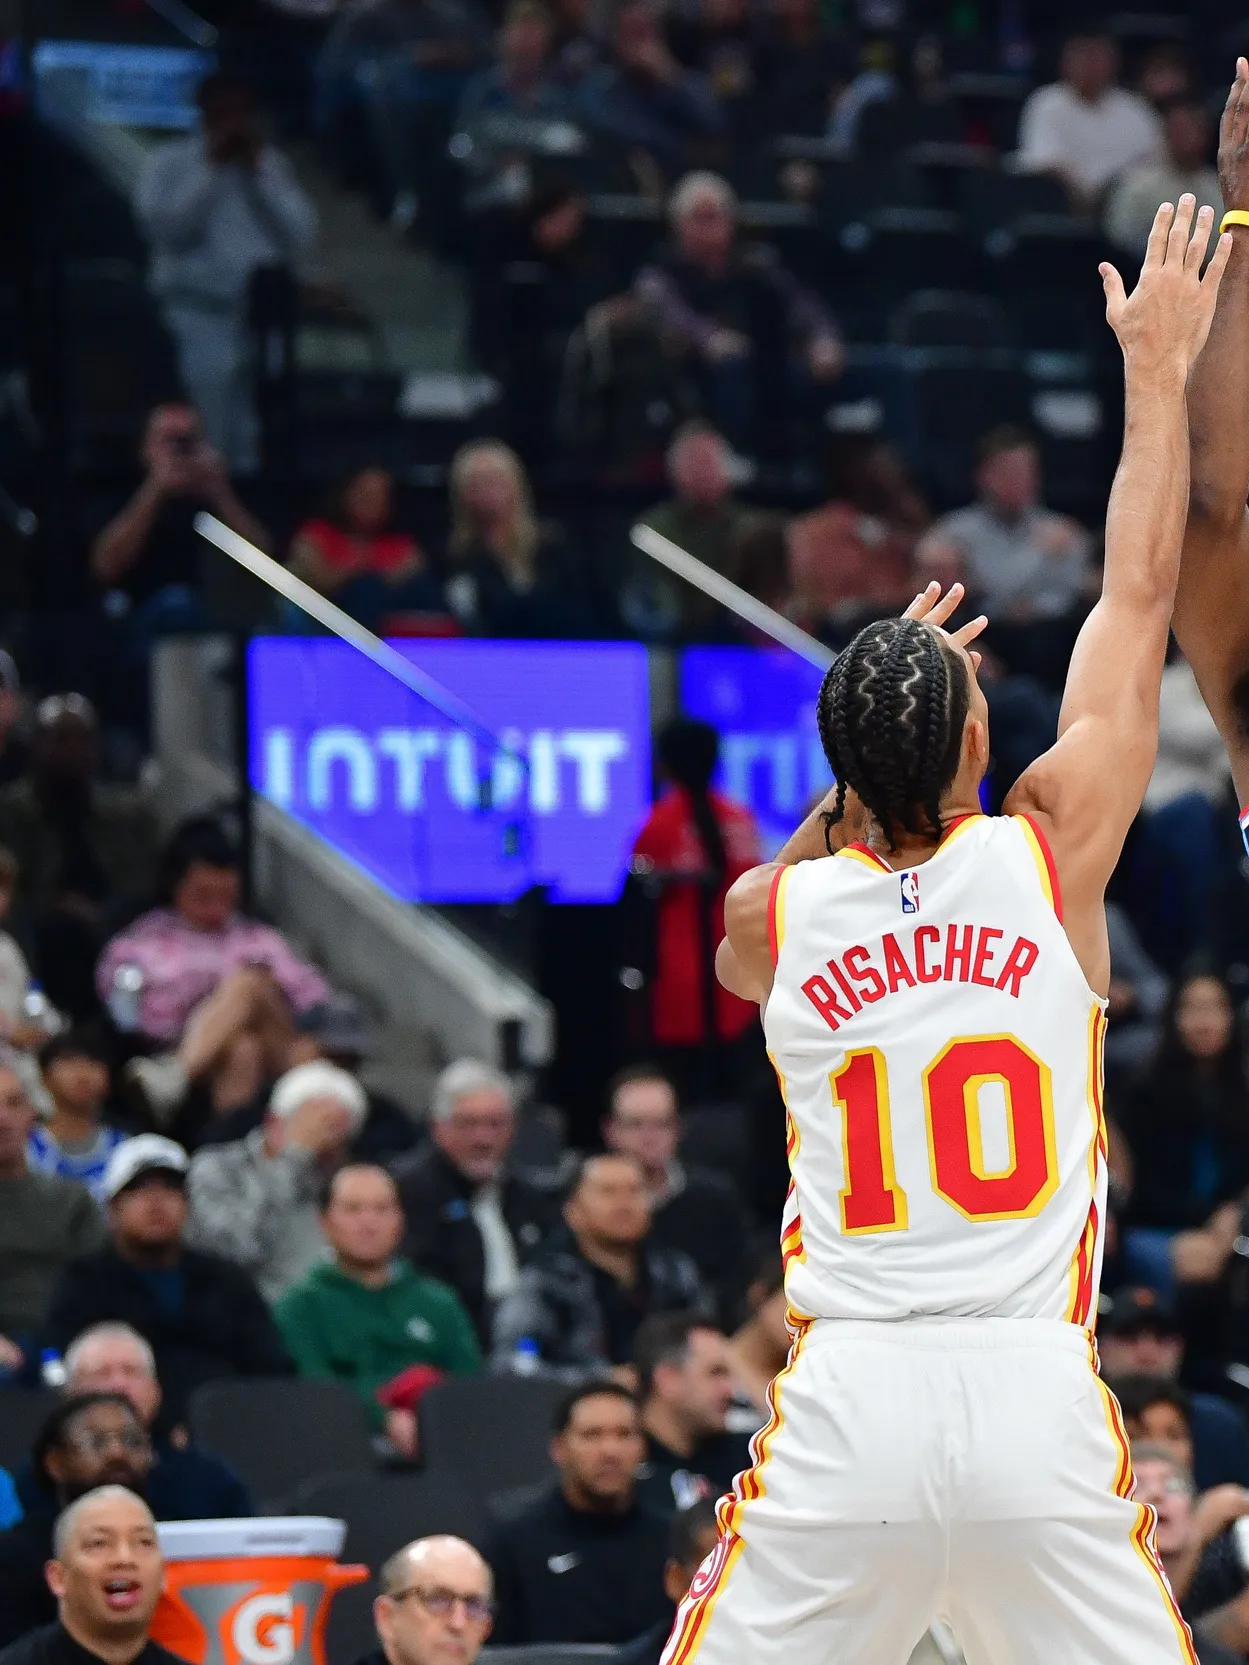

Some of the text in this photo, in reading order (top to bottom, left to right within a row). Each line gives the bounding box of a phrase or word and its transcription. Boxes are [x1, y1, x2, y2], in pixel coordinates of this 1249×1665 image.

[263, 728, 629, 814] INTUIT
[801, 924, 1040, 1032] RISACHER
[828, 1032, 1060, 1236] 10
[232, 1592, 293, 1664] G
